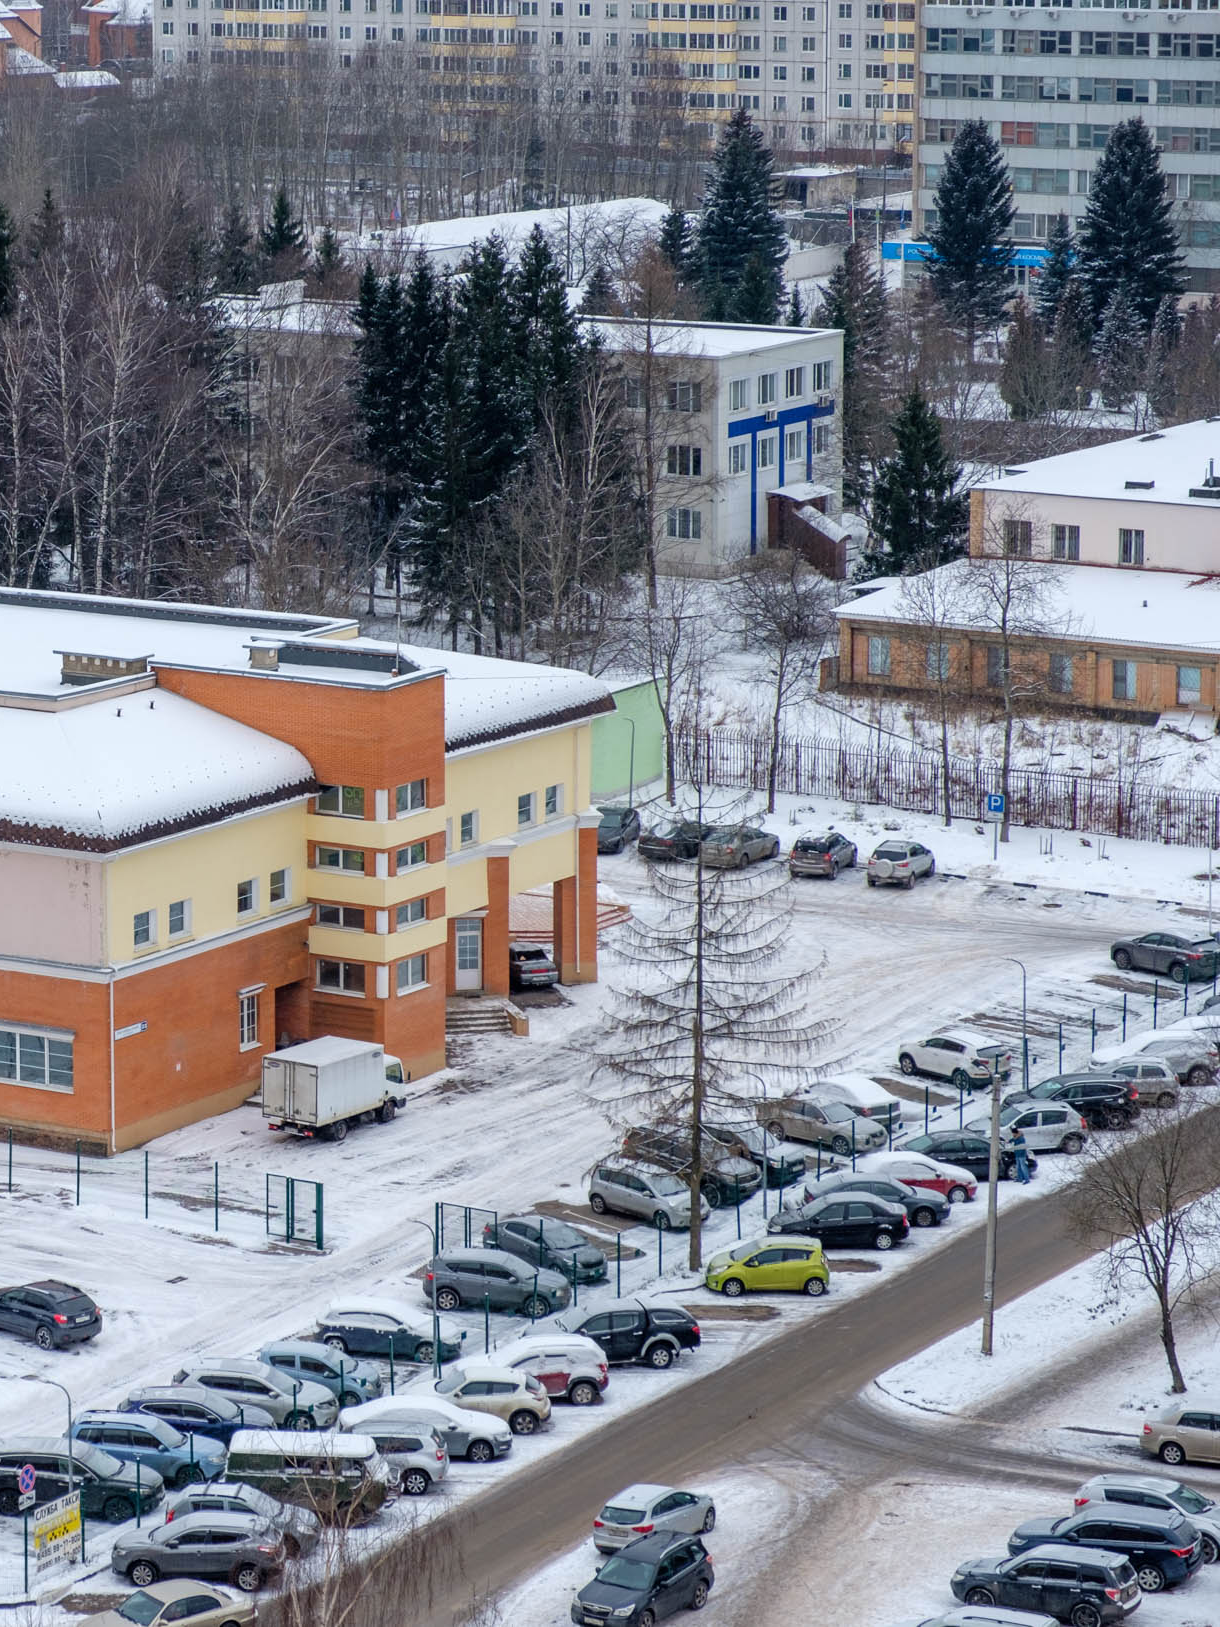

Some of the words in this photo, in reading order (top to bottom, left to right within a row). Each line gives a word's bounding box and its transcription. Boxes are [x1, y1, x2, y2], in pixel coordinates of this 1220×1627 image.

[991, 796, 1001, 810] P
[35, 1503, 58, 1521] СЛУЖБА
[61, 1494, 79, 1509] ТАКСИ
